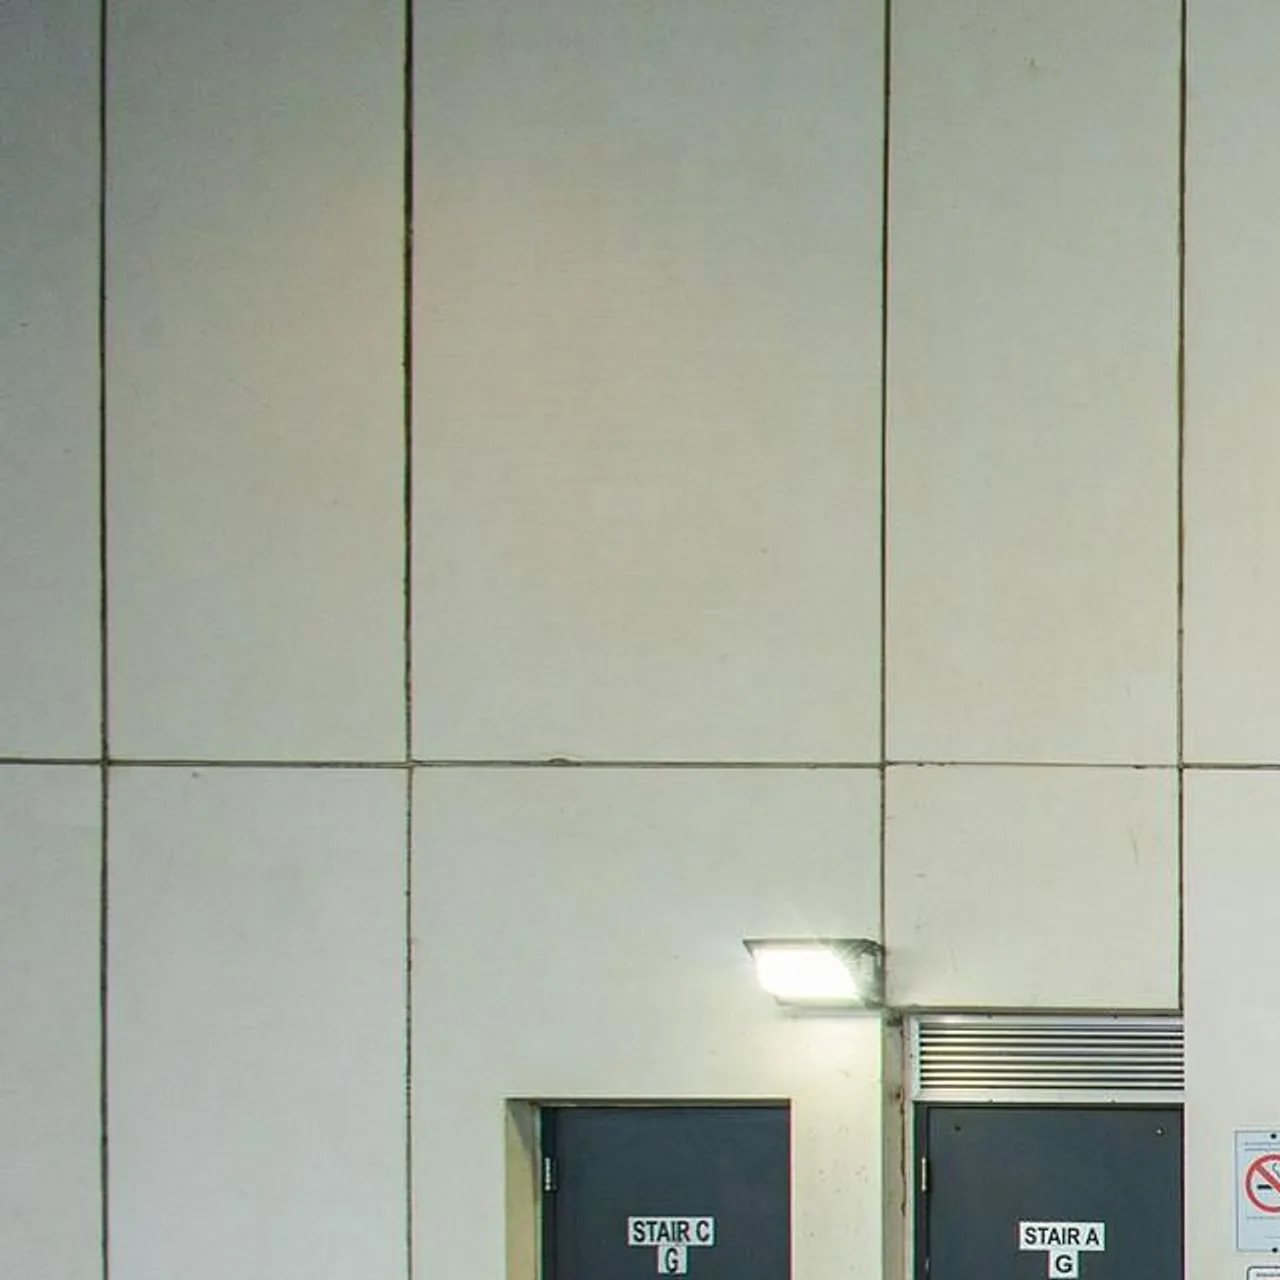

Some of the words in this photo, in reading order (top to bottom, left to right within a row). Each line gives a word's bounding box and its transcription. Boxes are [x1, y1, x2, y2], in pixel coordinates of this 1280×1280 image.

[633, 1220, 691, 1242] STAIR
[696, 1220, 710, 1242] C
[1024, 1227, 1080, 1245] STAIR
[1085, 1227, 1100, 1245] A
[665, 1248, 679, 1274] G
[1055, 1254, 1073, 1273] G
